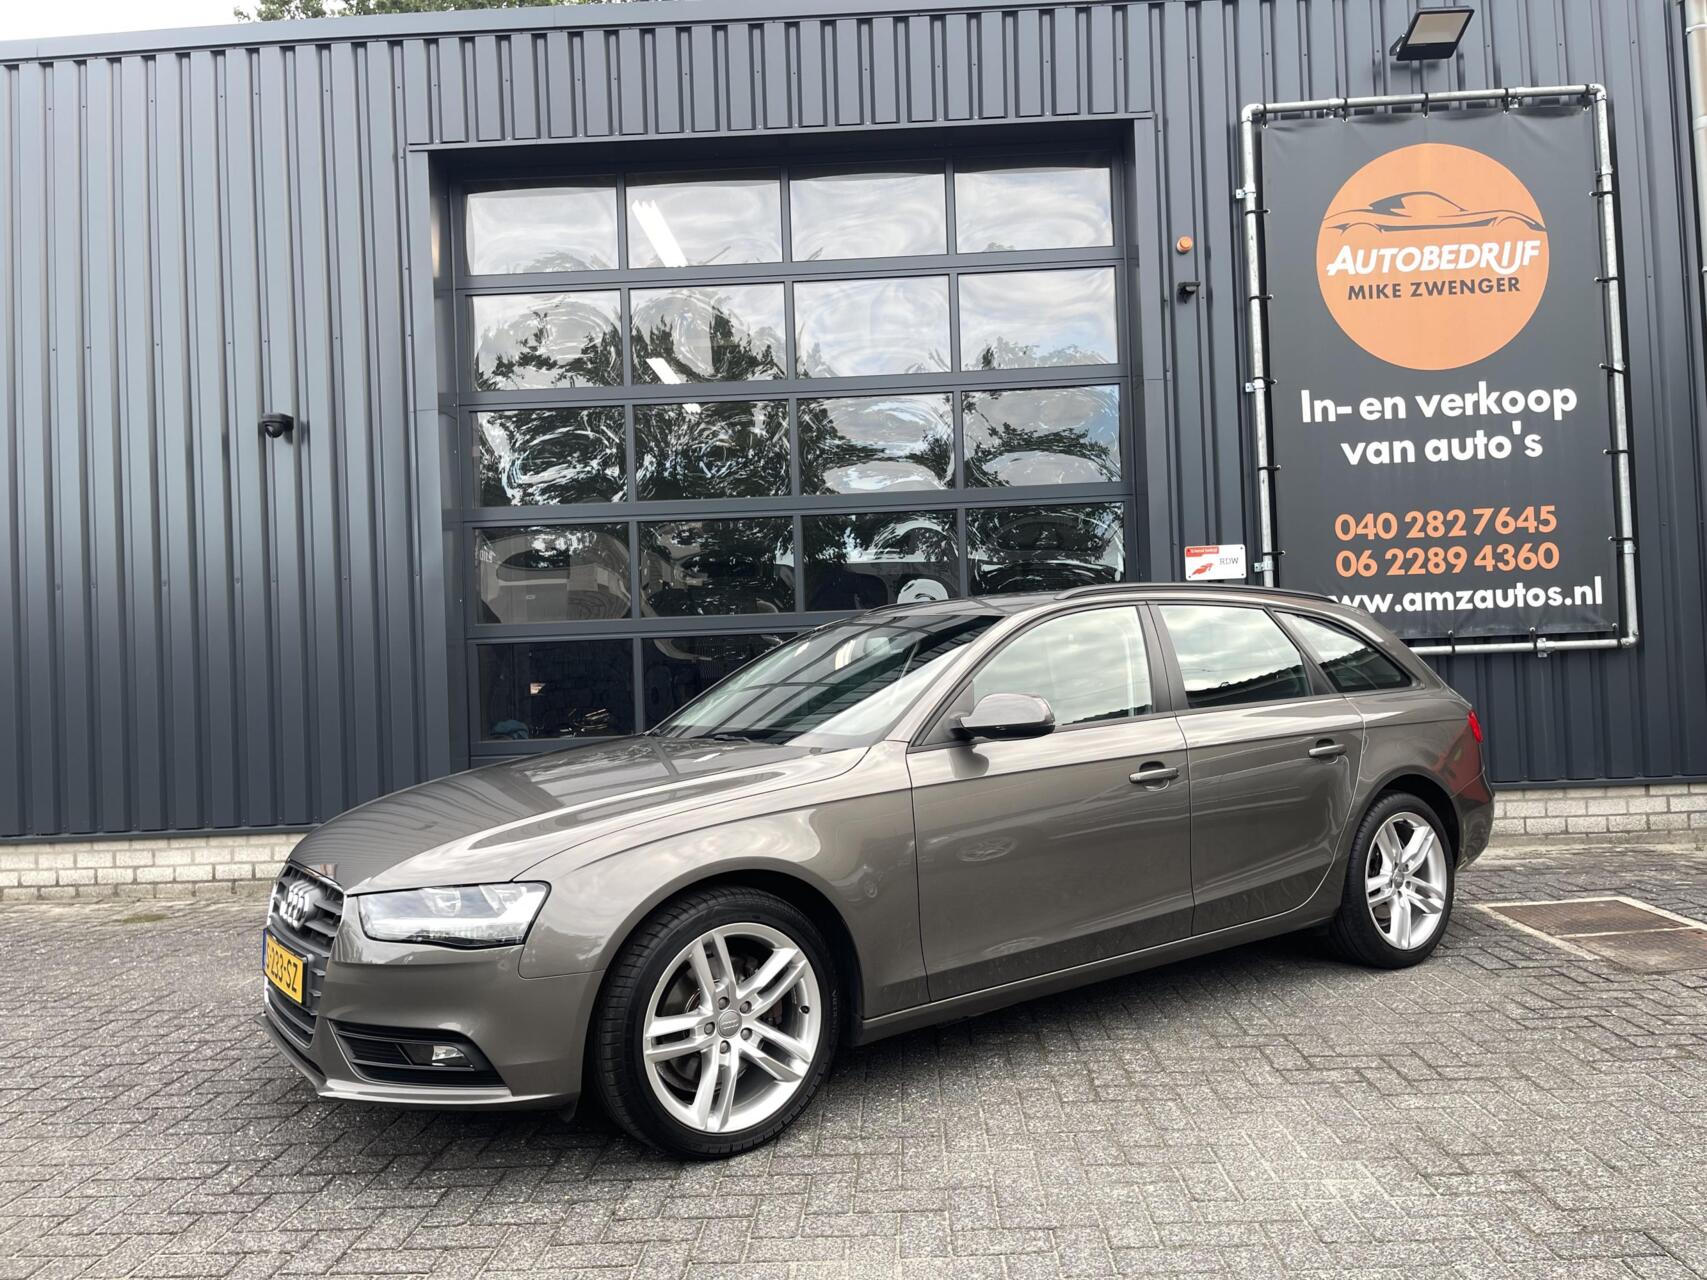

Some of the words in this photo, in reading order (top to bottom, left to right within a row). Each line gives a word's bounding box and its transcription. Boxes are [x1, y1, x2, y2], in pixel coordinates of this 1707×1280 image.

[1327, 240, 1540, 275] AUTOBEDRIJF
[1348, 284, 1402, 300] MIKE
[1411, 277, 1520, 297] ZWENGER
[1301, 390, 1352, 422] In-
[1359, 396, 1406, 420] en
[1415, 381, 1577, 421] verkoop
[1341, 440, 1415, 465] van
[1425, 420, 1543, 461] auto's
[1335, 512, 1397, 541] 040
[1406, 509, 1466, 538] 282
[1473, 505, 1557, 534] 7645
[1336, 550, 1378, 577] 06
[1386, 546, 1467, 575] 2289
[1474, 543, 1560, 571] 4360
[1326, 576, 1603, 613] ww.amzautos.nl
